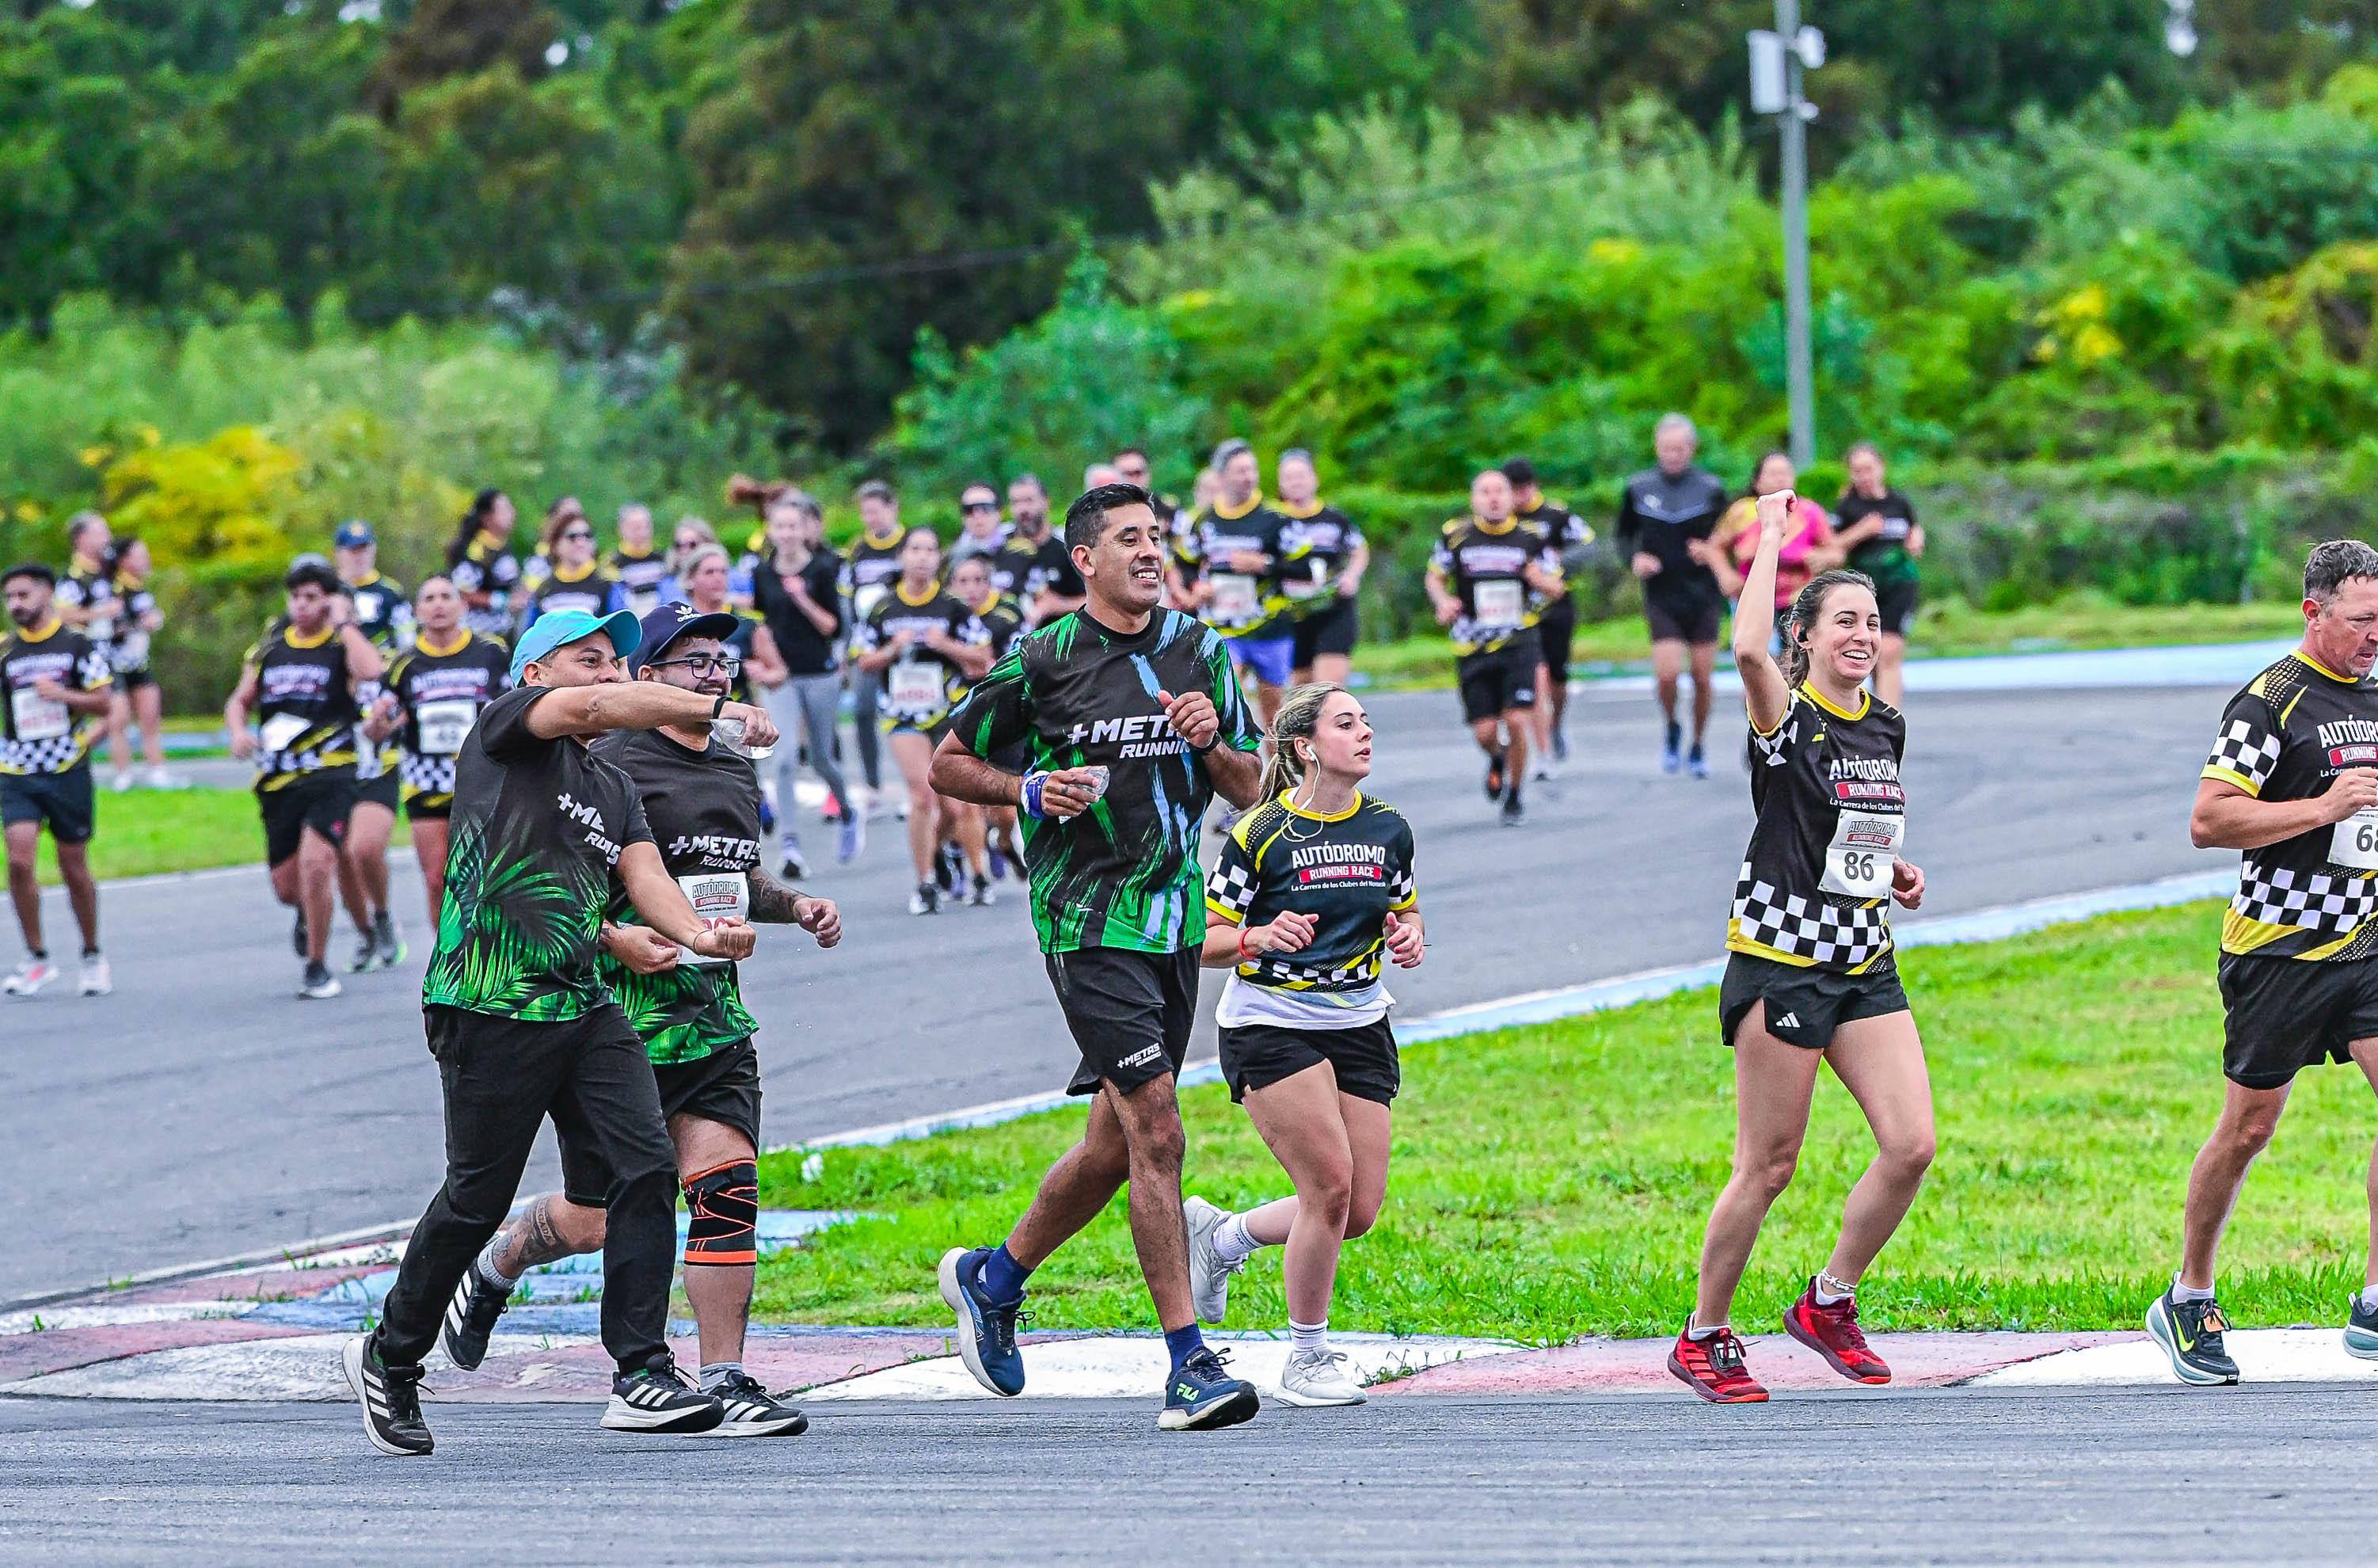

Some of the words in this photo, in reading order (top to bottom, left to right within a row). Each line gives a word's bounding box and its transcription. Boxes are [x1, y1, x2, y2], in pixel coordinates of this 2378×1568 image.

[1067, 714, 1178, 745] +MET
[2316, 714, 2378, 749] AUTÓDR
[1119, 740, 1191, 759] RUNNIN
[2340, 746, 2376, 763] RUNNING
[1847, 783, 1884, 797] RUNNING
[1839, 800, 1861, 809] Carrera
[1292, 840, 1386, 869] AUTÓDROMO
[1309, 866, 1349, 881] RUNNING
[1351, 866, 1375, 877] RACE
[1844, 851, 1874, 881] 86
[1117, 1042, 1160, 1069] +METAS
[1176, 1382, 1200, 1401] FILA
